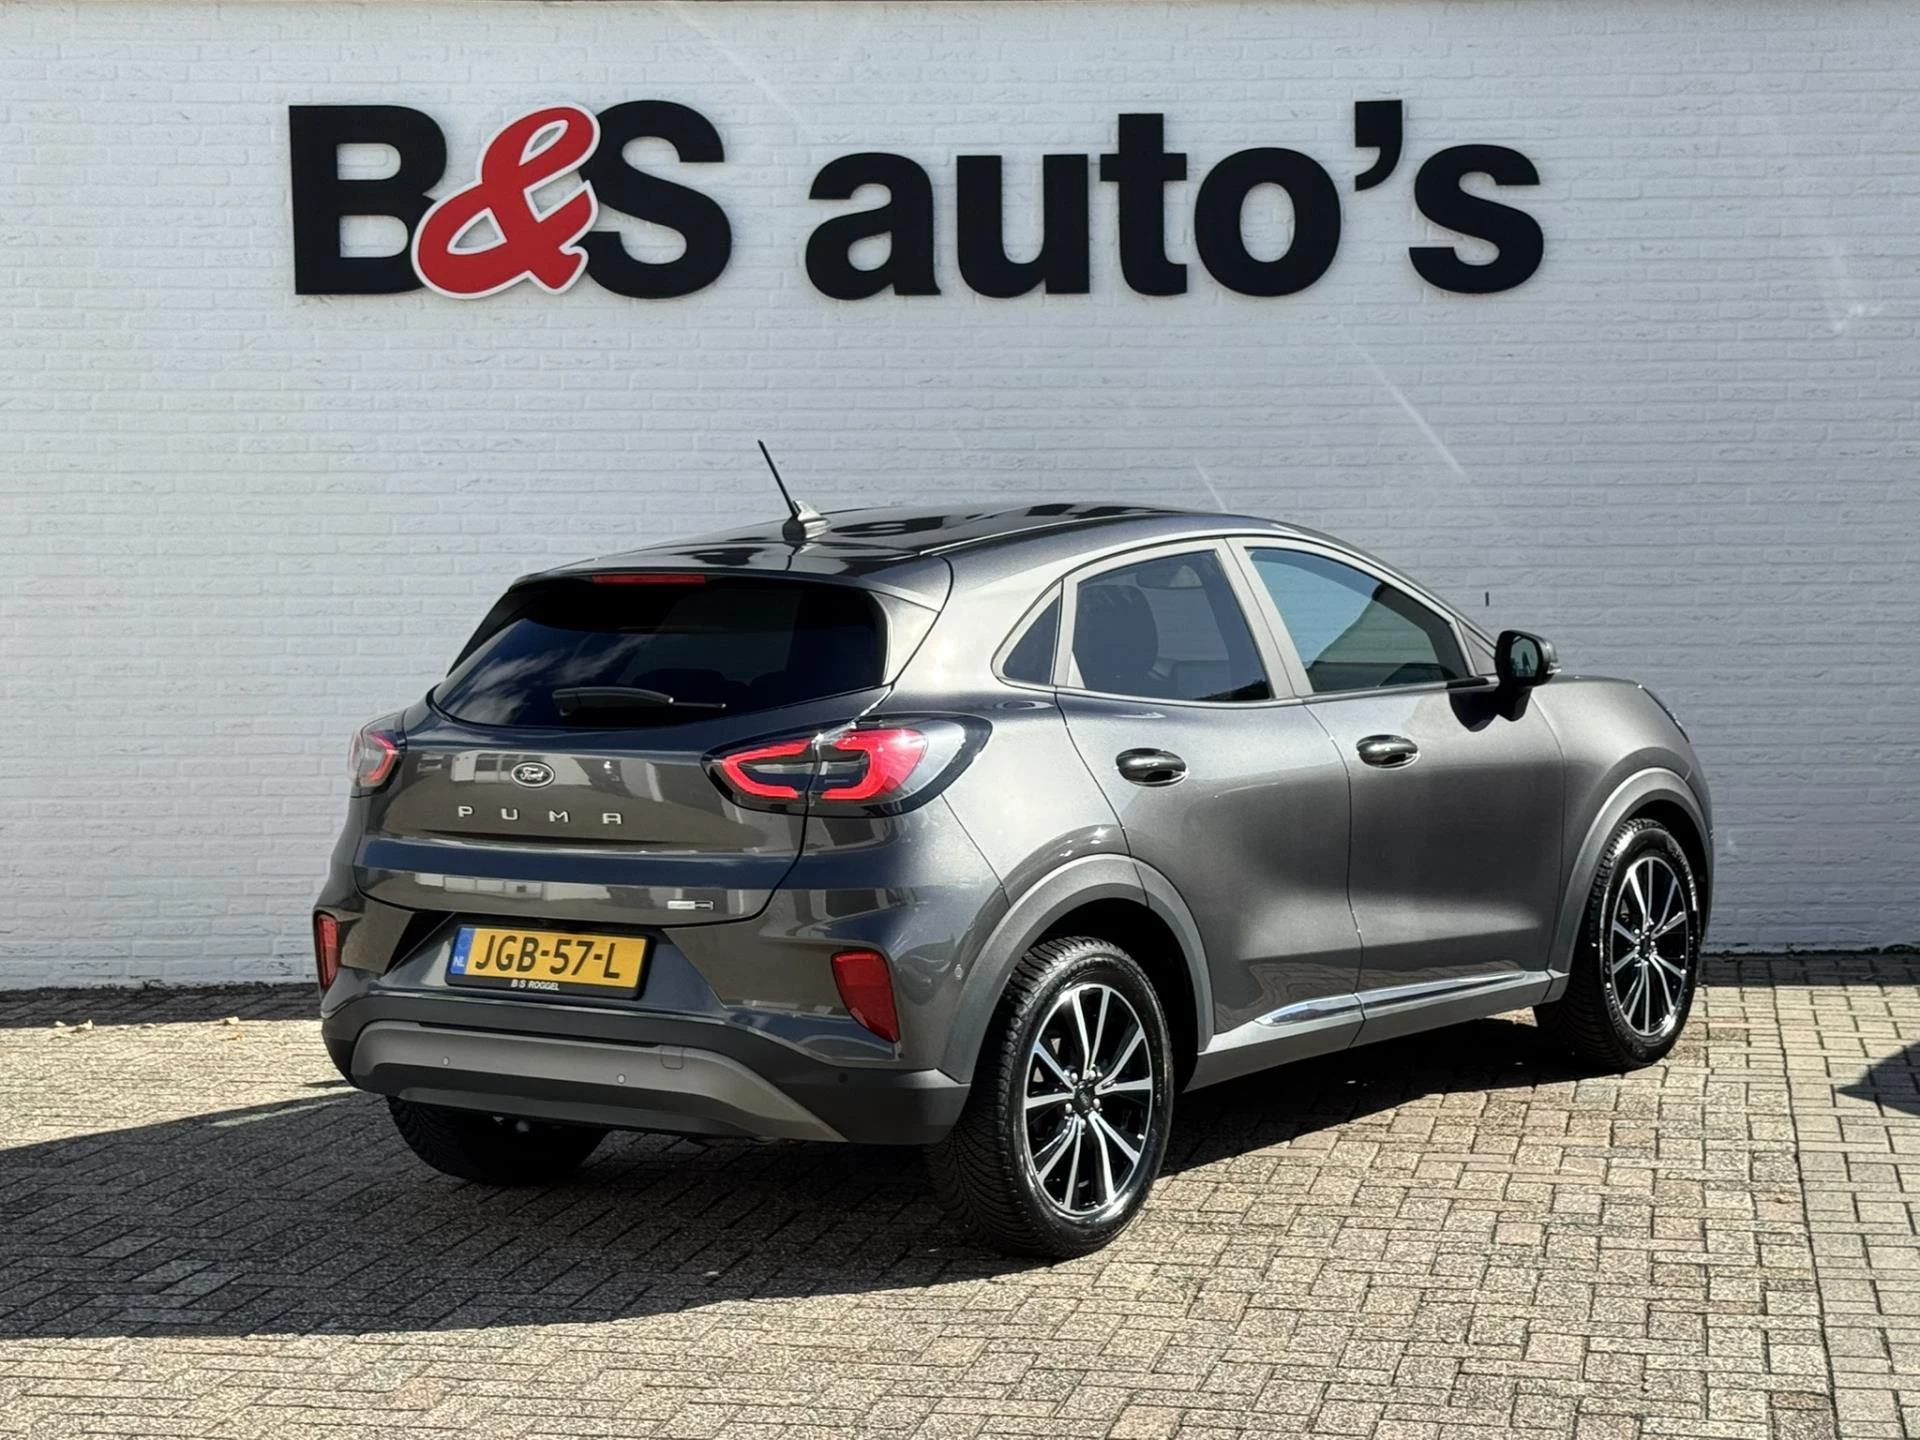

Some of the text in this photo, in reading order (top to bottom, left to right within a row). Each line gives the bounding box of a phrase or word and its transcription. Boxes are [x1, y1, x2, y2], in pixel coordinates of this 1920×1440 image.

[289, 99, 1545, 299] B&S auto's
[458, 806, 623, 825] PUMA
[452, 955, 465, 968] NL
[475, 935, 621, 979] JGB-57-L
[528, 980, 560, 991] ROGGEL
